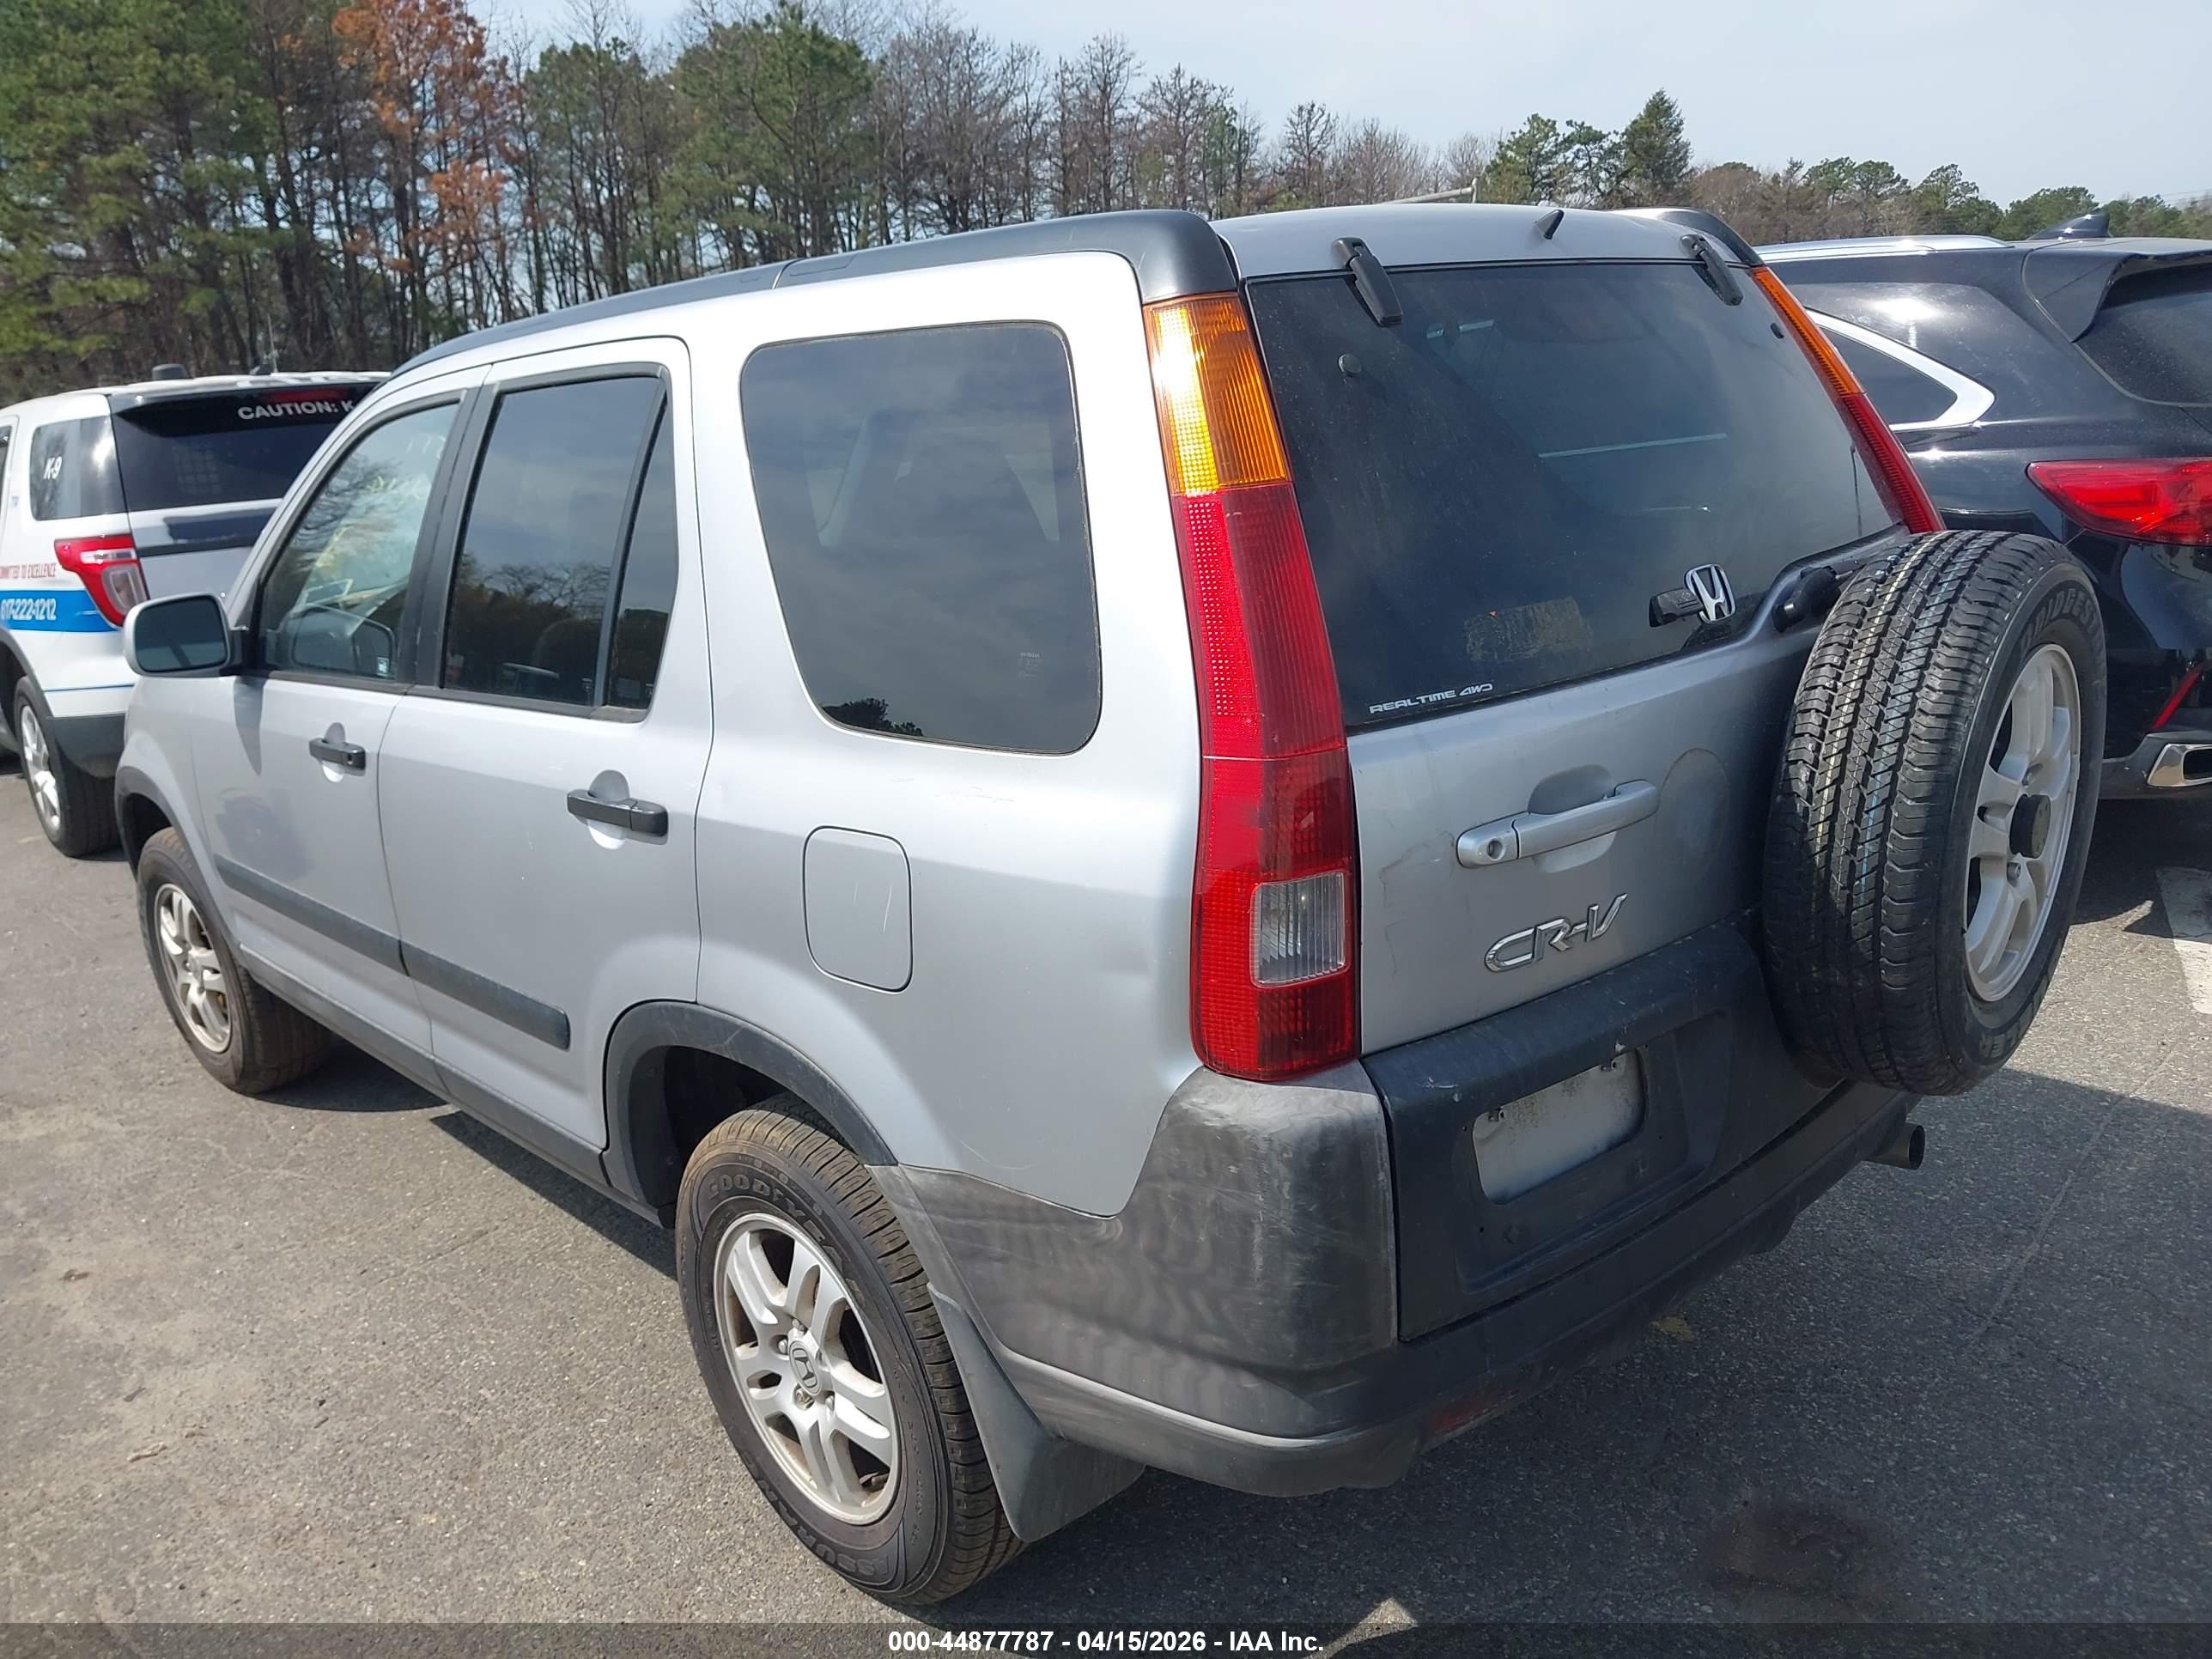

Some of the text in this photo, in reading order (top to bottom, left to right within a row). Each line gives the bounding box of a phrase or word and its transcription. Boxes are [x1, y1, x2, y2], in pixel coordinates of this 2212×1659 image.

[237, 400, 338, 419] CAUTION:
[44, 456, 63, 479] K-9
[1369, 690, 1457, 714] REALTIME
[1484, 893, 1628, 973] CR-V
